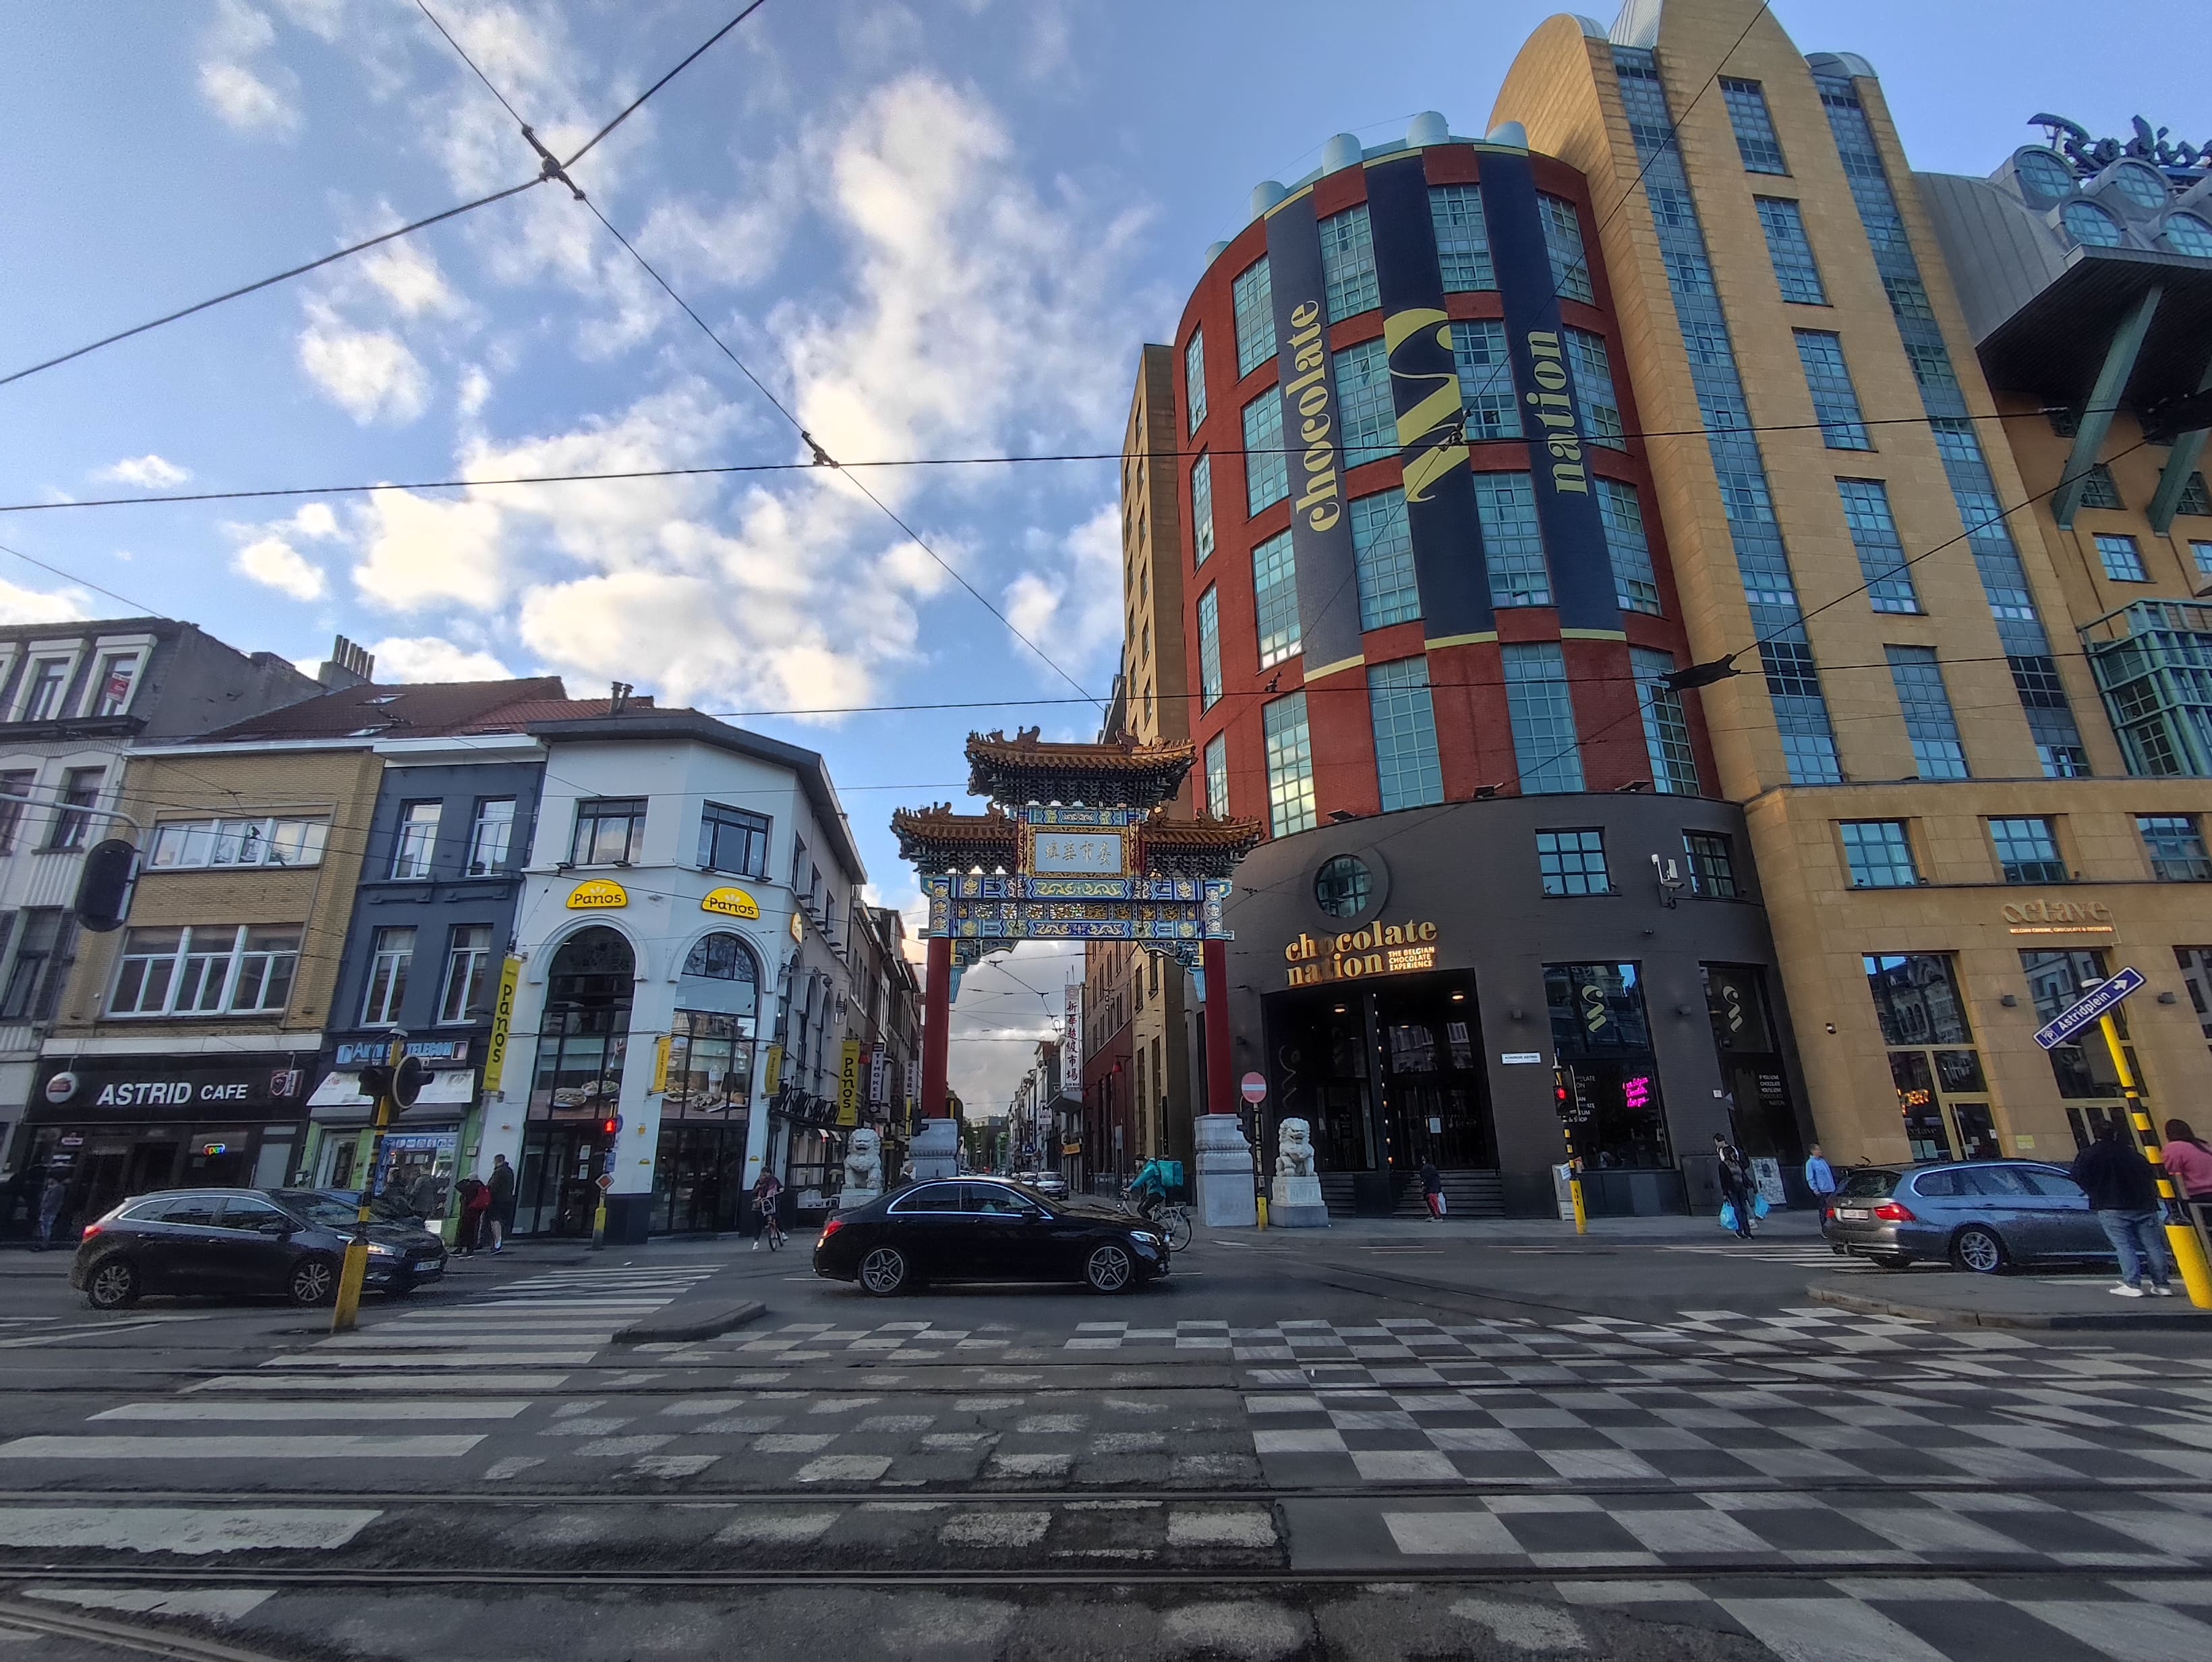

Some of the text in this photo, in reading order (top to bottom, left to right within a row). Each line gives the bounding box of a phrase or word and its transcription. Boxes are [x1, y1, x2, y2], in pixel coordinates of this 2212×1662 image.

[1285, 299, 1341, 533] chocolate
[1526, 330, 1589, 497] nation
[574, 893, 622, 905] Panos
[709, 897, 755, 915] Panos
[2001, 898, 2109, 923] octave
[1285, 919, 1438, 961] chocolate
[1403, 946, 1435, 956] BELGIAN
[1286, 952, 1385, 986] nation
[1389, 954, 1431, 965] CHOCOLATE
[1389, 960, 1434, 971] EXPERIENCE
[492, 984, 513, 1063] Panos
[2058, 992, 2112, 1031] Astridplein
[406, 1042, 453, 1056] TELECOM
[96, 1082, 249, 1105] ASTRID CAFE
[842, 1057, 854, 1108] Panos
